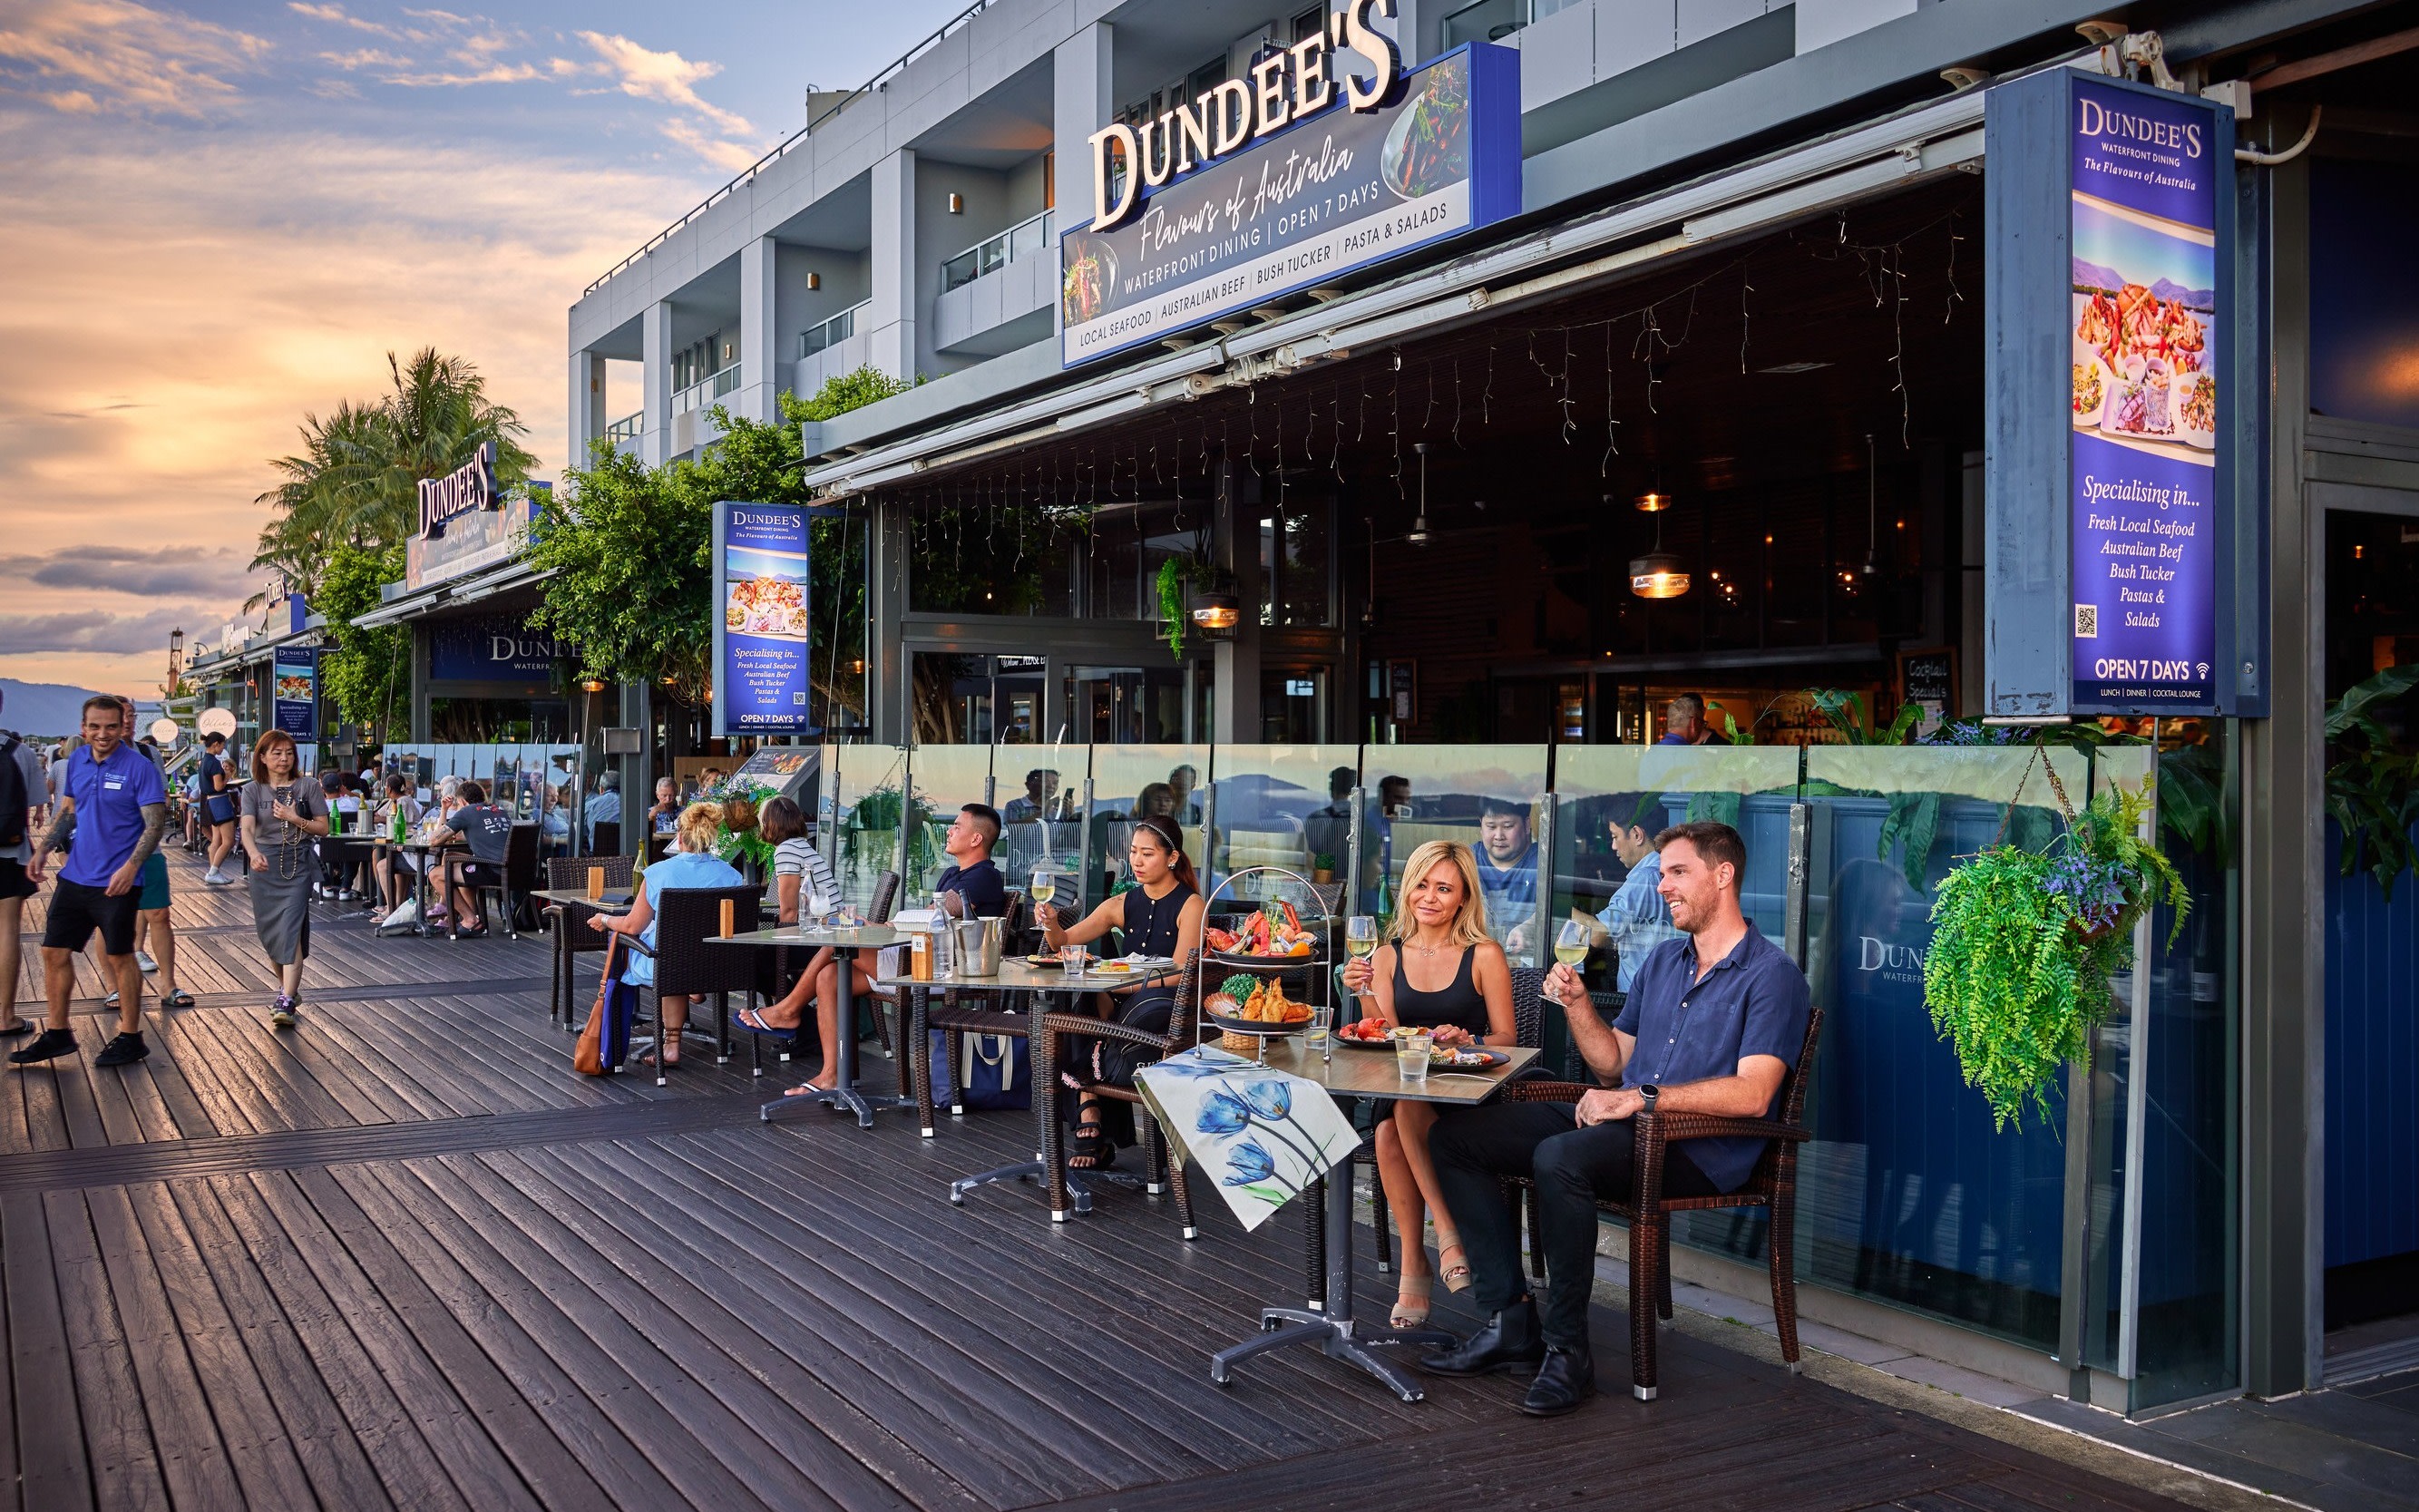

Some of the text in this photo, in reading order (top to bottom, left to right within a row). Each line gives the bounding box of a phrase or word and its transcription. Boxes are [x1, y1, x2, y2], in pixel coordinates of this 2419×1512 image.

[1088, 0, 1398, 233] DUNDEE'S
[2079, 98, 2201, 158] DUNDEE'S
[2101, 141, 2180, 167] WATERFRONT DINING
[2084, 157, 2196, 190] The Flavours of Australia
[1139, 134, 1353, 261] Flavours of Australia
[1124, 180, 1379, 295] WATERFRONT DINING OPEN 7 DAYS
[1079, 202, 1448, 347] LOCAL SEAFOOD AUSTRALIAN BEEF BUSH TUCKER PASTA & SALADS
[418, 443, 488, 541] DUNDEE'S
[2082, 474, 2200, 510] Specialising in...
[733, 511, 801, 528] DUNDEE'S
[2088, 513, 2195, 539] Fresh Local Seafood
[2101, 539, 2184, 562] Australian Beef
[2110, 562, 2175, 581] Bush Tucker
[2120, 587, 2165, 604] Pastas &
[2125, 611, 2161, 628] Salads
[735, 648, 783, 659] Specialising
[1908, 660, 1947, 683] Cocktail
[2095, 658, 2190, 680] OPEN 7 DAYS
[1908, 682, 1946, 701] Specials
[2101, 688, 2201, 698] LUNCH DINNER COCKTAIL LOUNGE
[740, 715, 794, 723] OPEN 7 DAYS
